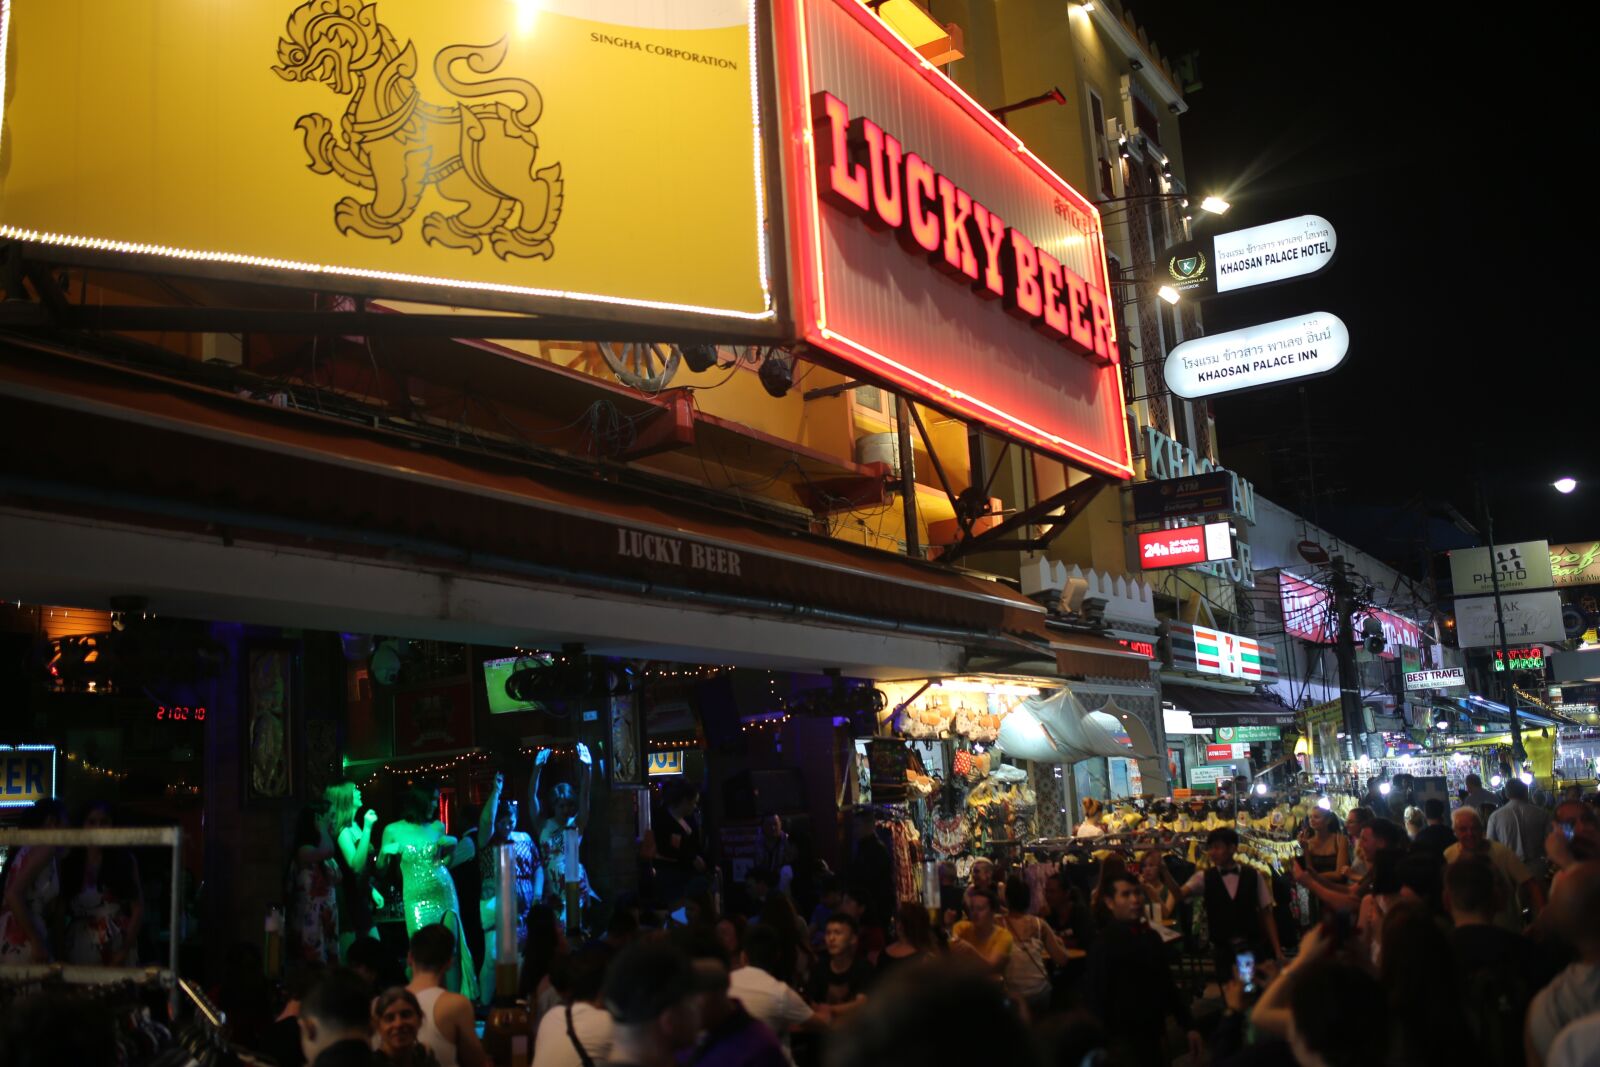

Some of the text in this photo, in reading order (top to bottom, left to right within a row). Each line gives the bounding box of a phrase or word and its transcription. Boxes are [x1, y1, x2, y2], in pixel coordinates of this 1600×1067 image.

[590, 32, 738, 70] SINGHA CORPORATION
[824, 91, 1120, 366] LUCKY BEER
[1220, 240, 1332, 275] KHAOSAN PALACE HOTEL
[1182, 355, 1219, 370] โรงแรม
[1198, 348, 1319, 383] KHAOSAN PALACE INN
[617, 528, 742, 577] LUCKY BEER
[1169, 543, 1200, 556] Banking
[1549, 543, 1600, 570] oof
[1473, 569, 1527, 585] PHOTO
[1407, 669, 1464, 683] BEST TRAVEL
[0, 757, 45, 795] ER
